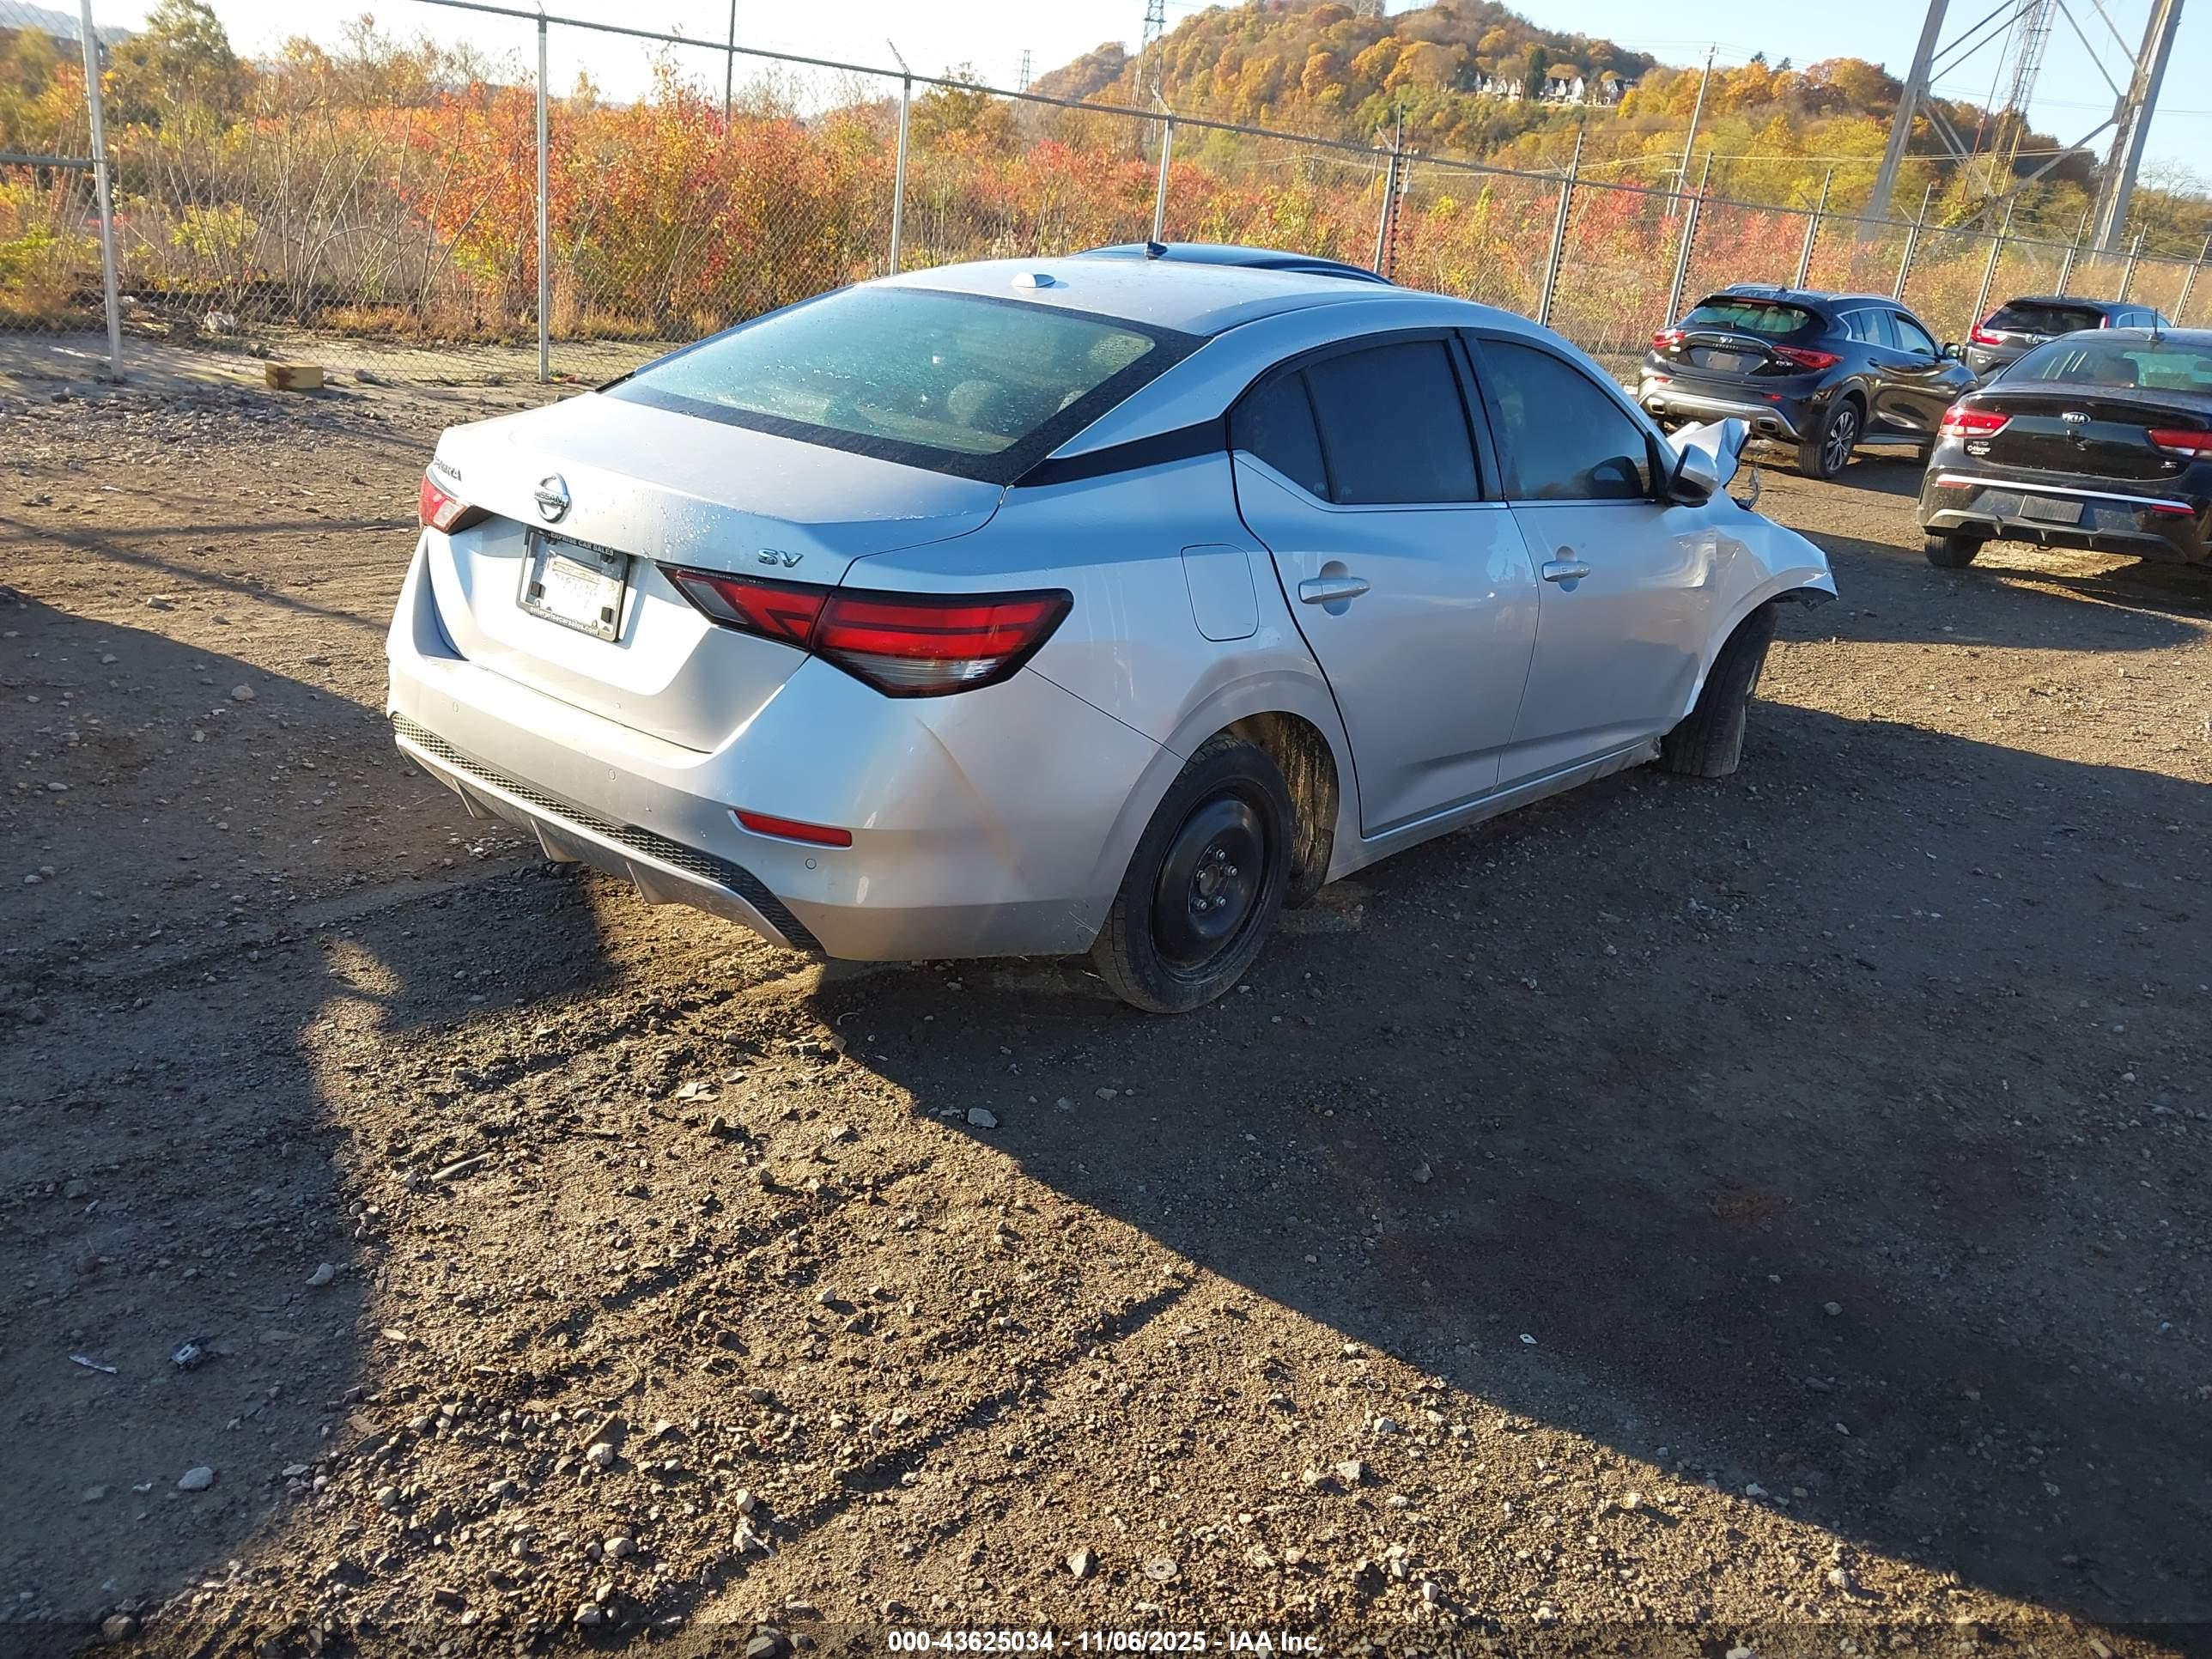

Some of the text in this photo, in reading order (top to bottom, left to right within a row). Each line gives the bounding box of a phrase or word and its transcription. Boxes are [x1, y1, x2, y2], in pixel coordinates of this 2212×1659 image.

[534, 490, 564, 505] NISSAN
[577, 538, 592, 550] CAR
[592, 543, 614, 556] SALES
[757, 548, 805, 568] SV
